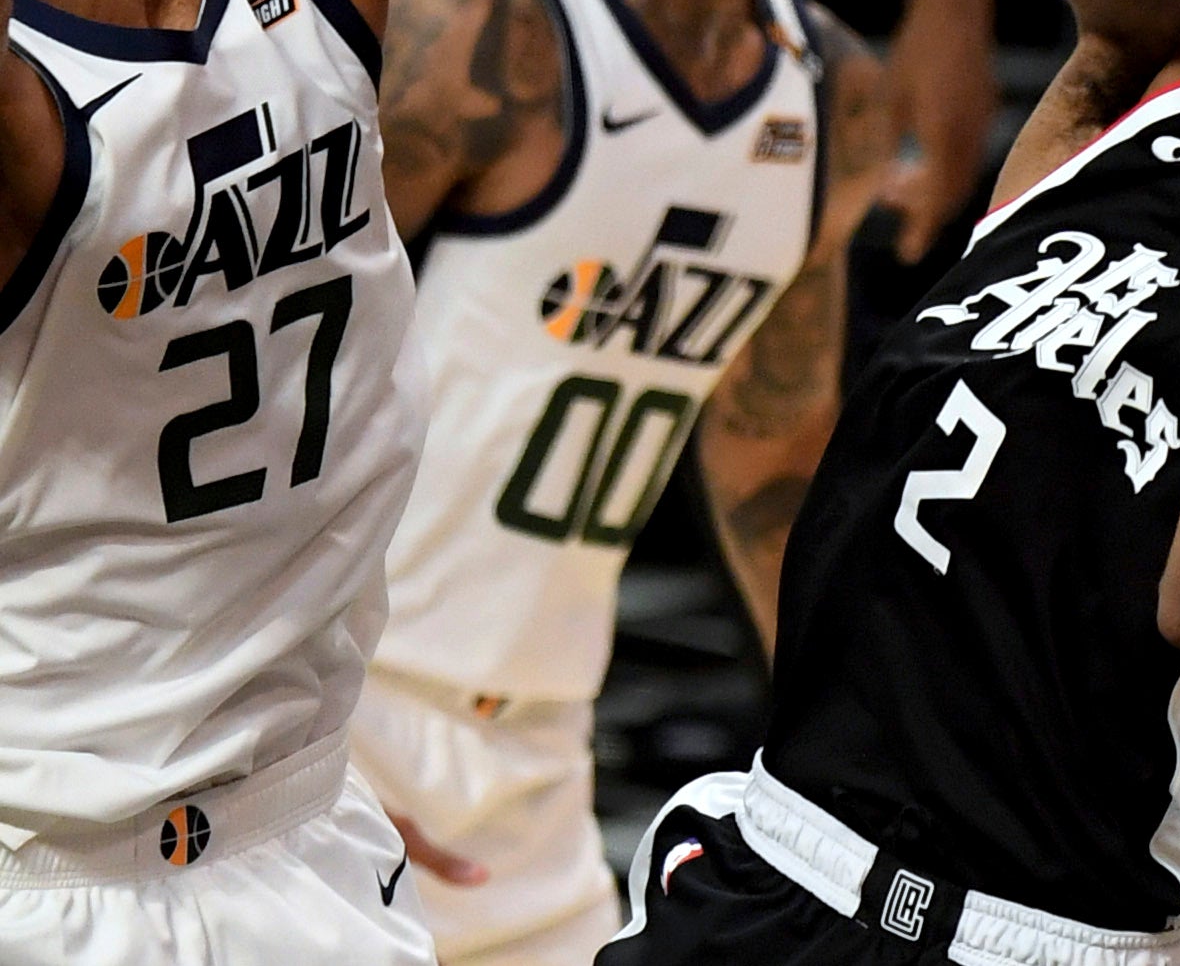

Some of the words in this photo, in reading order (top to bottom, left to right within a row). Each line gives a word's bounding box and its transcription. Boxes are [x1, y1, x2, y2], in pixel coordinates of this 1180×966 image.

[140, 102, 369, 309] JAZZ
[568, 206, 777, 366] JAZZ
[157, 274, 353, 524] 27
[494, 374, 694, 550] 00
[894, 377, 1007, 576] 2
